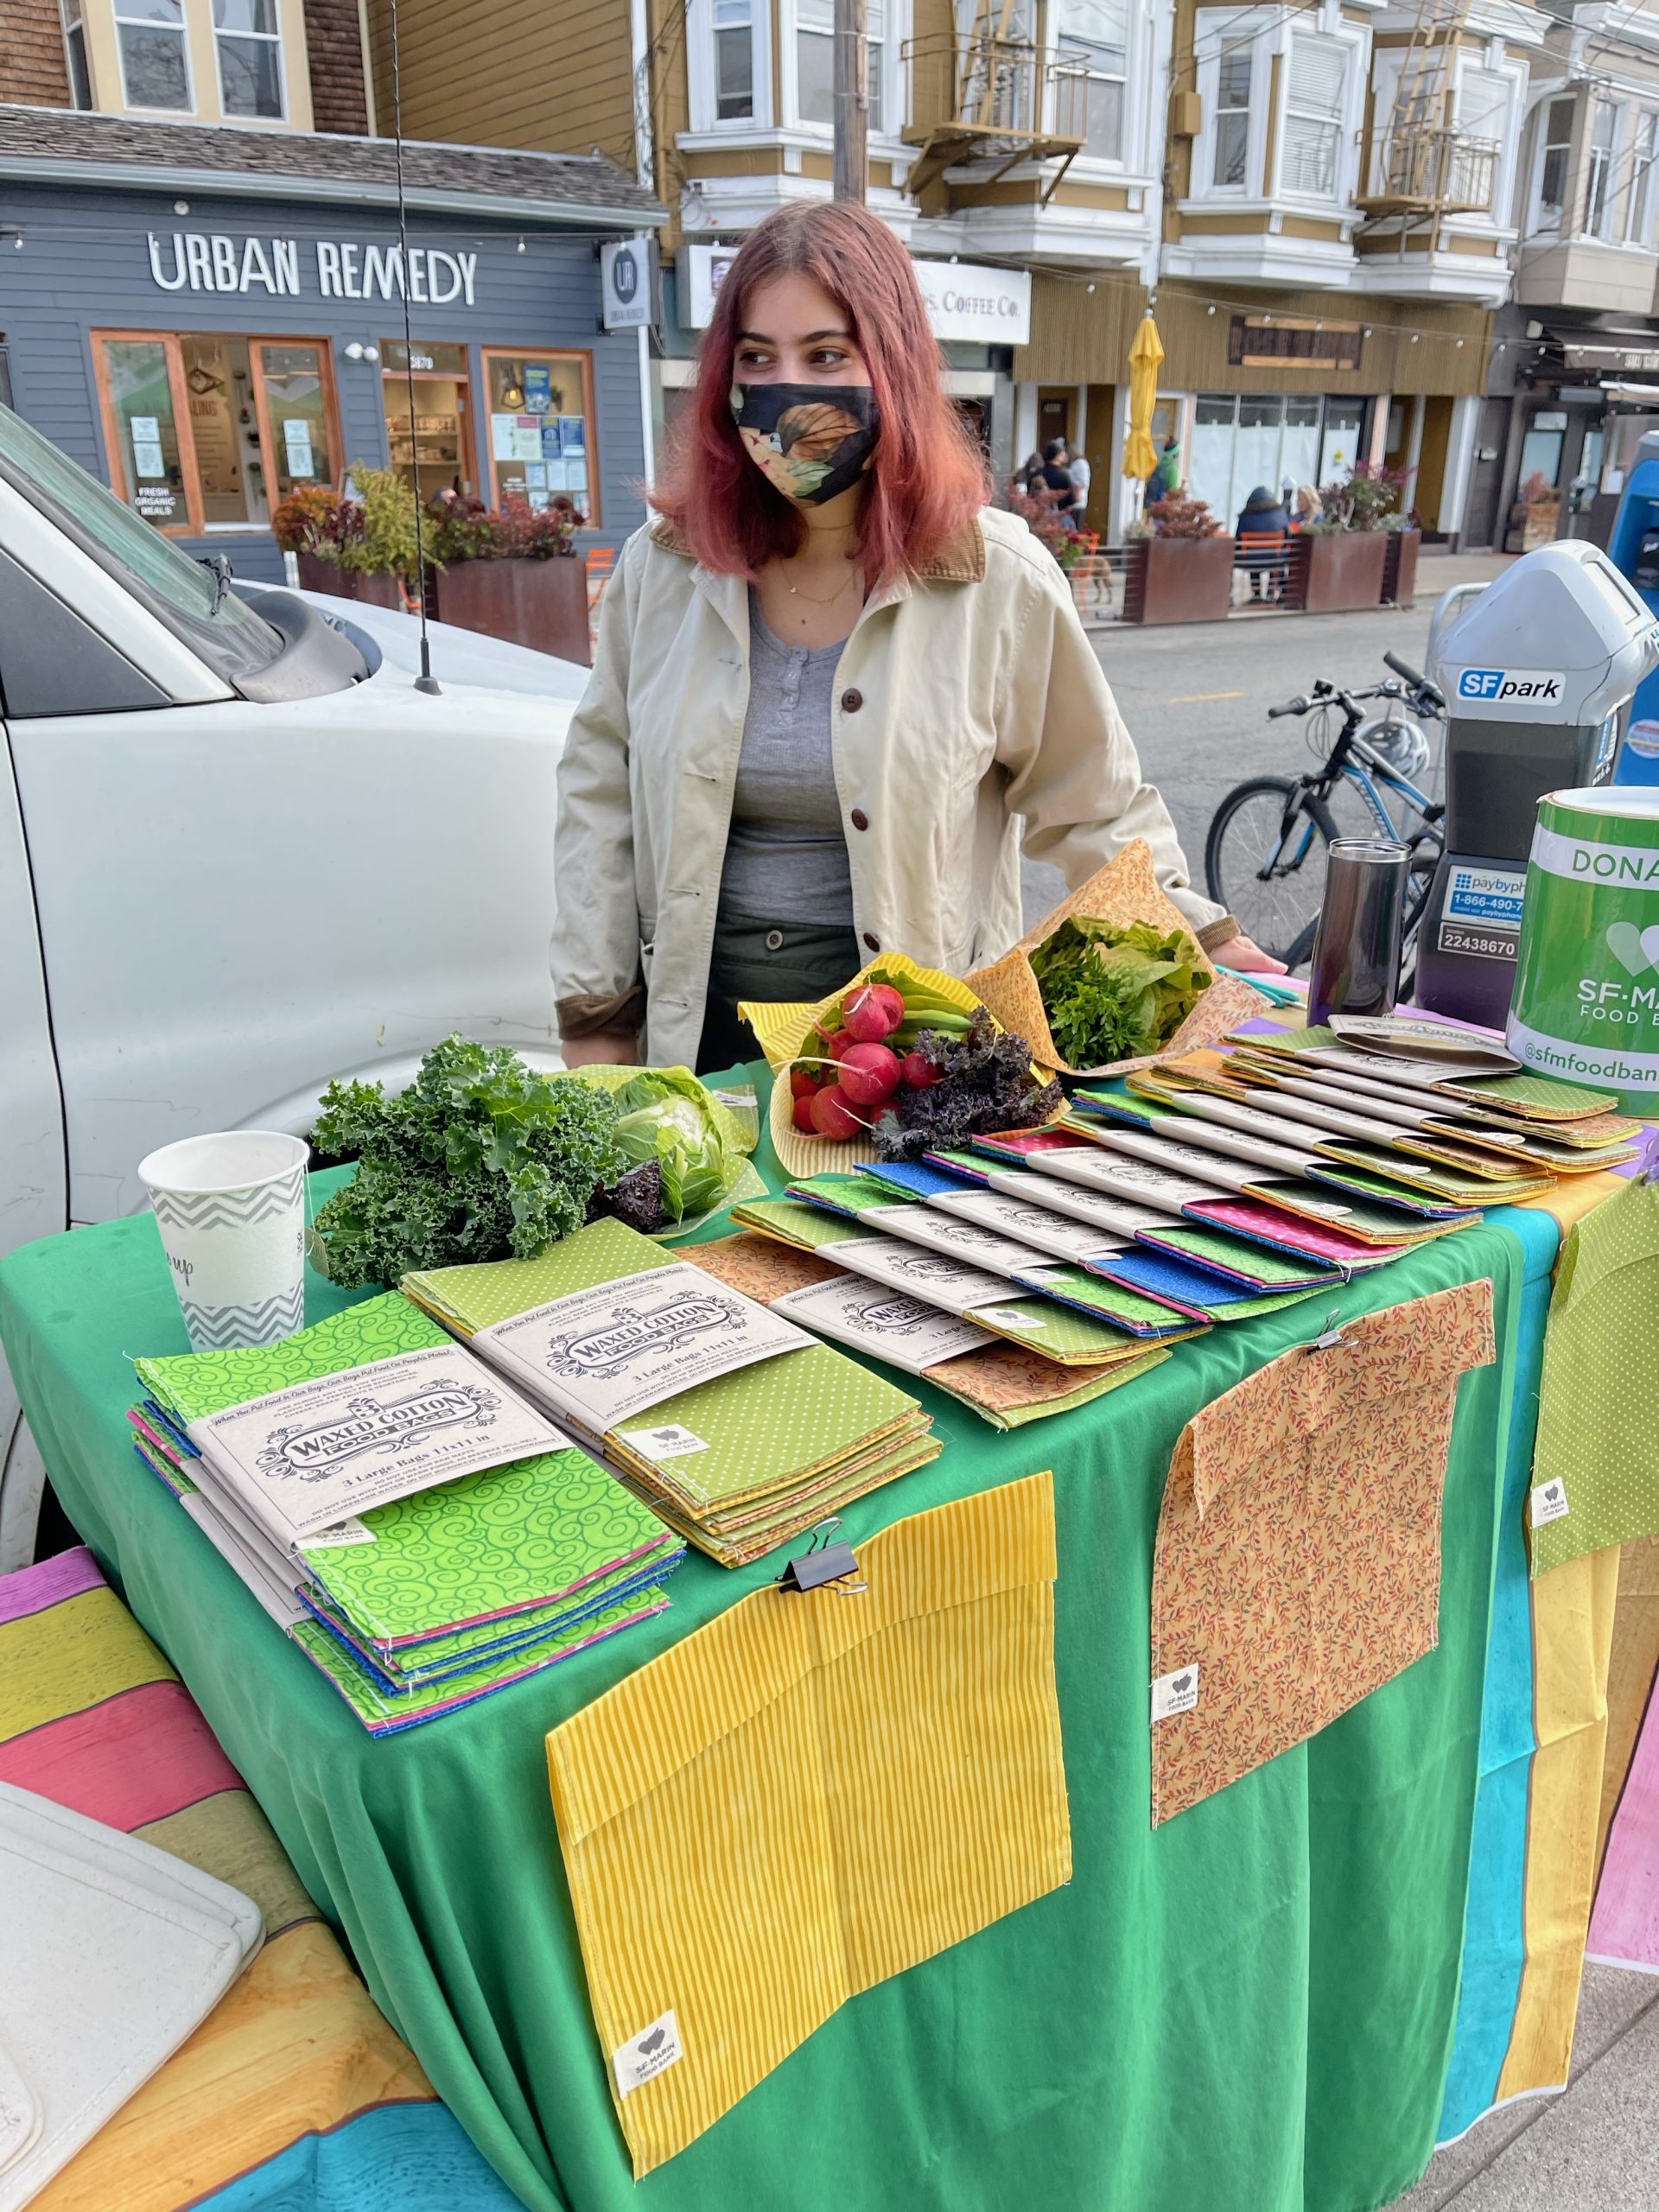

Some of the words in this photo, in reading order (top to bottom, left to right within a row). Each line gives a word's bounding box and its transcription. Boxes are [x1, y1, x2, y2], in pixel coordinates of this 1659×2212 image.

[147, 231, 301, 296] URBAN
[315, 241, 477, 306] REMEDY
[135, 497, 175, 506] ORGANIC
[138, 486, 169, 497] FRESH
[140, 506, 172, 516] MEALS
[1444, 934, 1516, 955] 22438670
[1580, 1005, 1639, 1024] FOOD
[1525, 1042, 1659, 1081] @sfmfoodban
[620, 1313, 642, 1324] 3
[868, 1300, 923, 1320] WAXED
[575, 1326, 649, 1357] WAXED
[644, 1303, 715, 1332] COTTON
[605, 1332, 661, 1355] FOOD
[660, 1314, 707, 1335] BAGS
[642, 1363, 672, 1377] Large
[673, 1352, 702, 1363] Bags
[702, 1338, 734, 1352] 11x11
[214, 1414, 235, 1426] When
[251, 1402, 263, 1412] Put
[264, 1396, 283, 1407] Food
[373, 1363, 391, 1372] Food
[355, 1404, 380, 1417] 3
[291, 1421, 379, 1456] WAXED
[378, 1395, 466, 1429] COTTON
[325, 1428, 392, 1454] FOOD
[394, 1408, 452, 1432] BAGS
[355, 1465, 394, 1482] Large
[396, 1453, 429, 1466] Bags
[432, 1439, 472, 1454] 11x11
